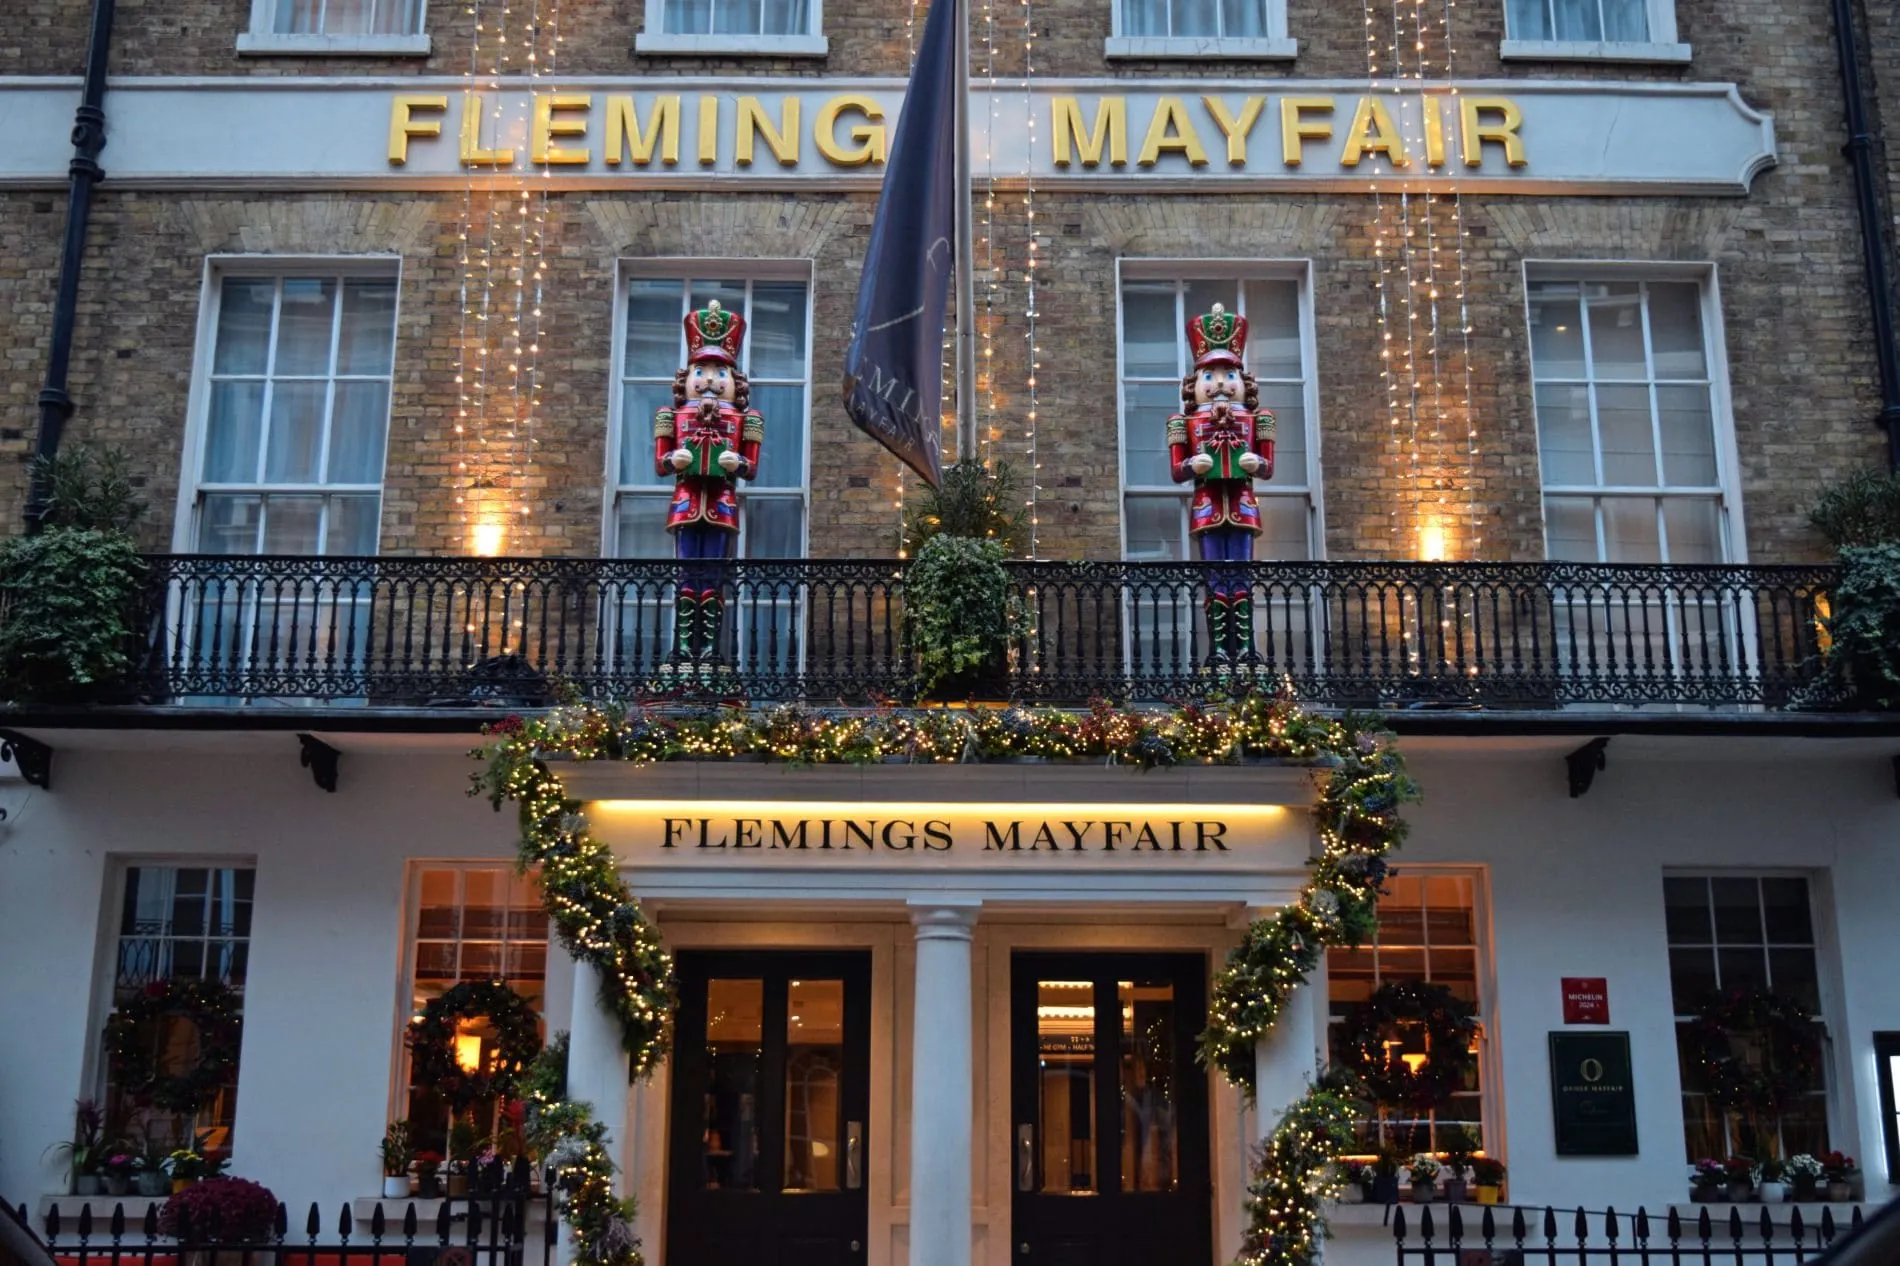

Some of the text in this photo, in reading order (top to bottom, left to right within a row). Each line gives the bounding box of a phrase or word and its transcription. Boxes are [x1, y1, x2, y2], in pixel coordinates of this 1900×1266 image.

[387, 93, 1529, 168] FLEMING MAYFAIR
[660, 817, 1232, 852] FLEMINGS MAYFAIR
[1568, 993, 1603, 1001] MICHELIN
